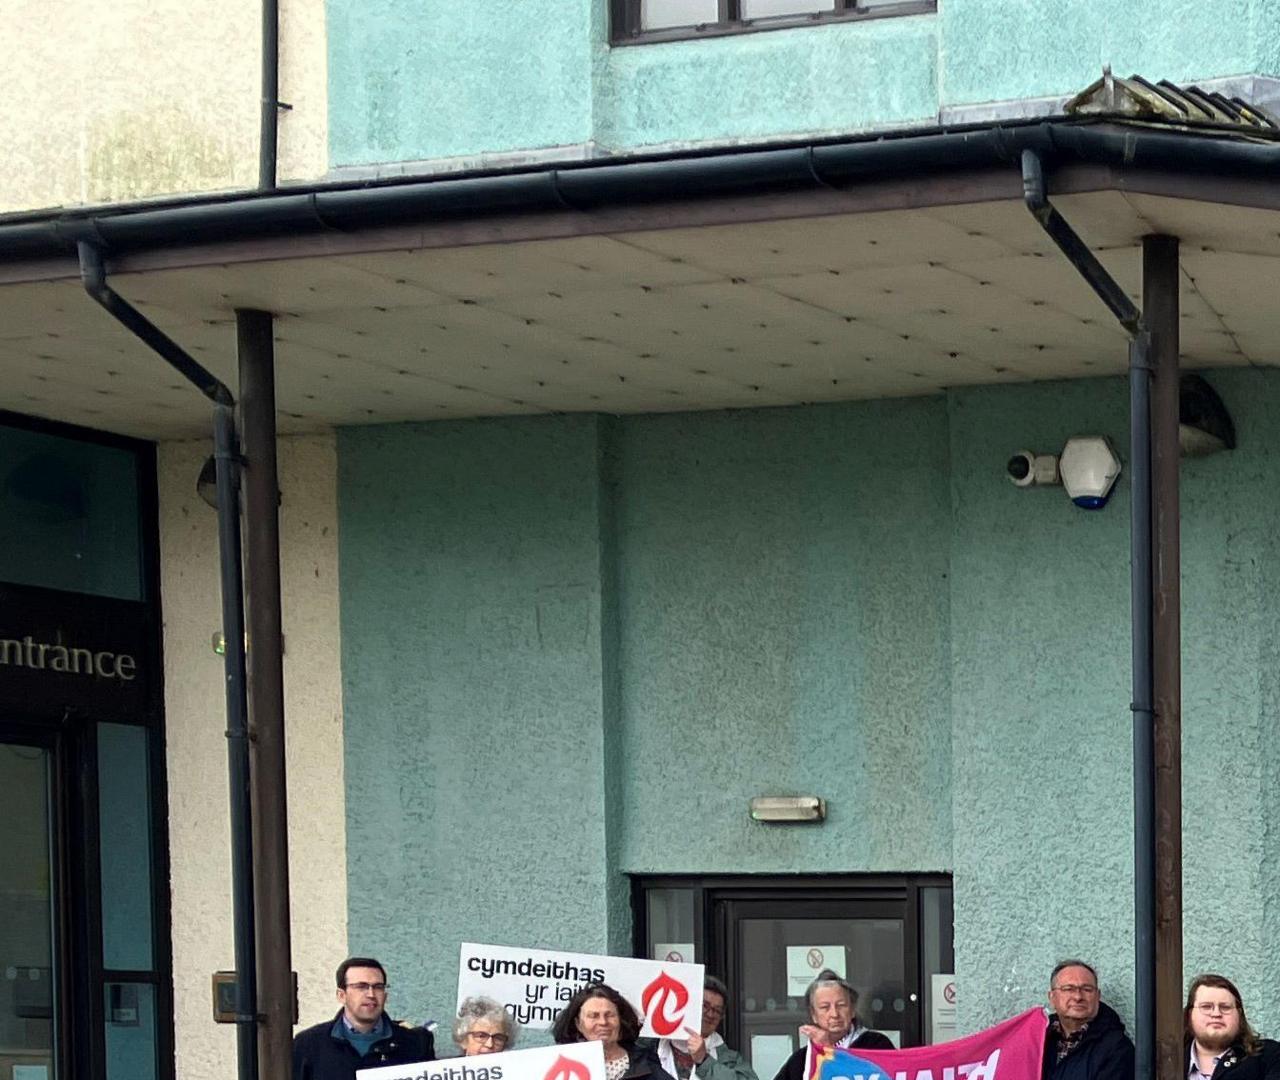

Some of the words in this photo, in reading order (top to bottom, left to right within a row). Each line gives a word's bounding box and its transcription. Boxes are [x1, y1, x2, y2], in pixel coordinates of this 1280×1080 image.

[0, 636, 136, 680] ntrance
[467, 956, 605, 983] cymdeithas
[525, 983, 549, 1003] yr
